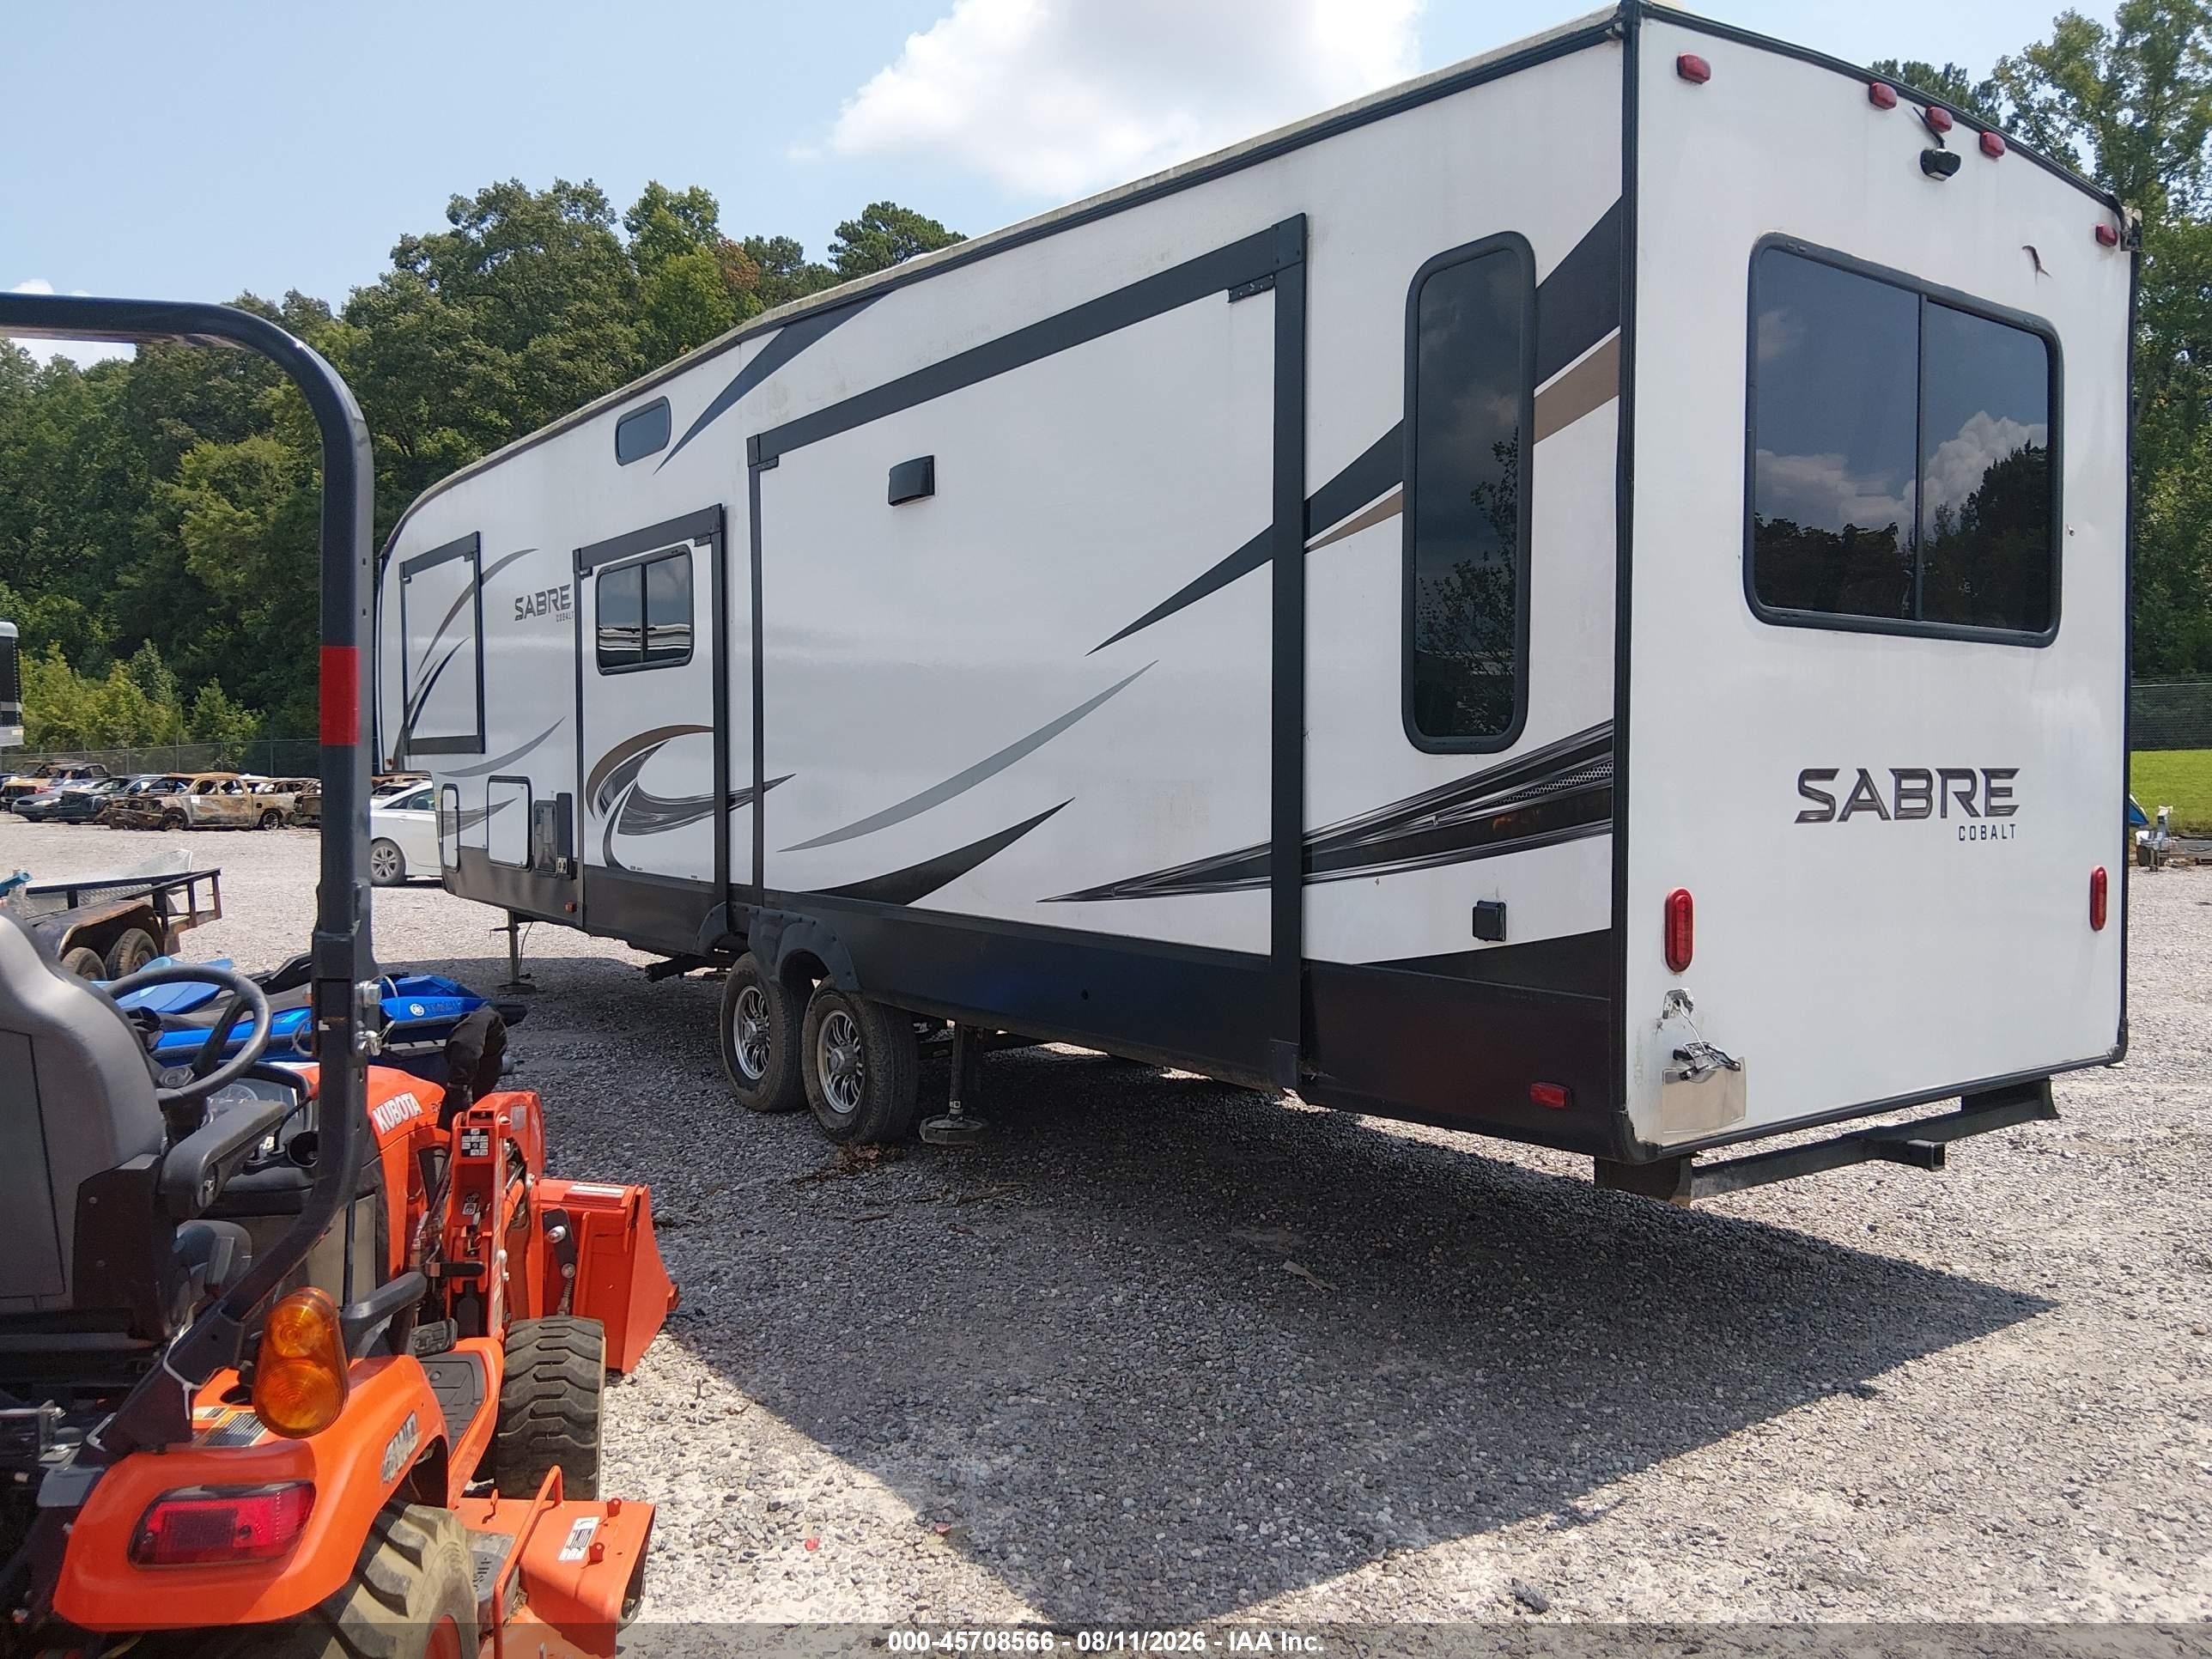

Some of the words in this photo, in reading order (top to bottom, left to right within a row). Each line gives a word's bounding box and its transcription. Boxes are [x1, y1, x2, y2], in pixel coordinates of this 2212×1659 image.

[514, 584, 571, 621] SABRE
[1794, 768, 2021, 823] SABRE
[1959, 823, 2016, 842] COBALT
[372, 1091, 423, 1135] KUBOTA
